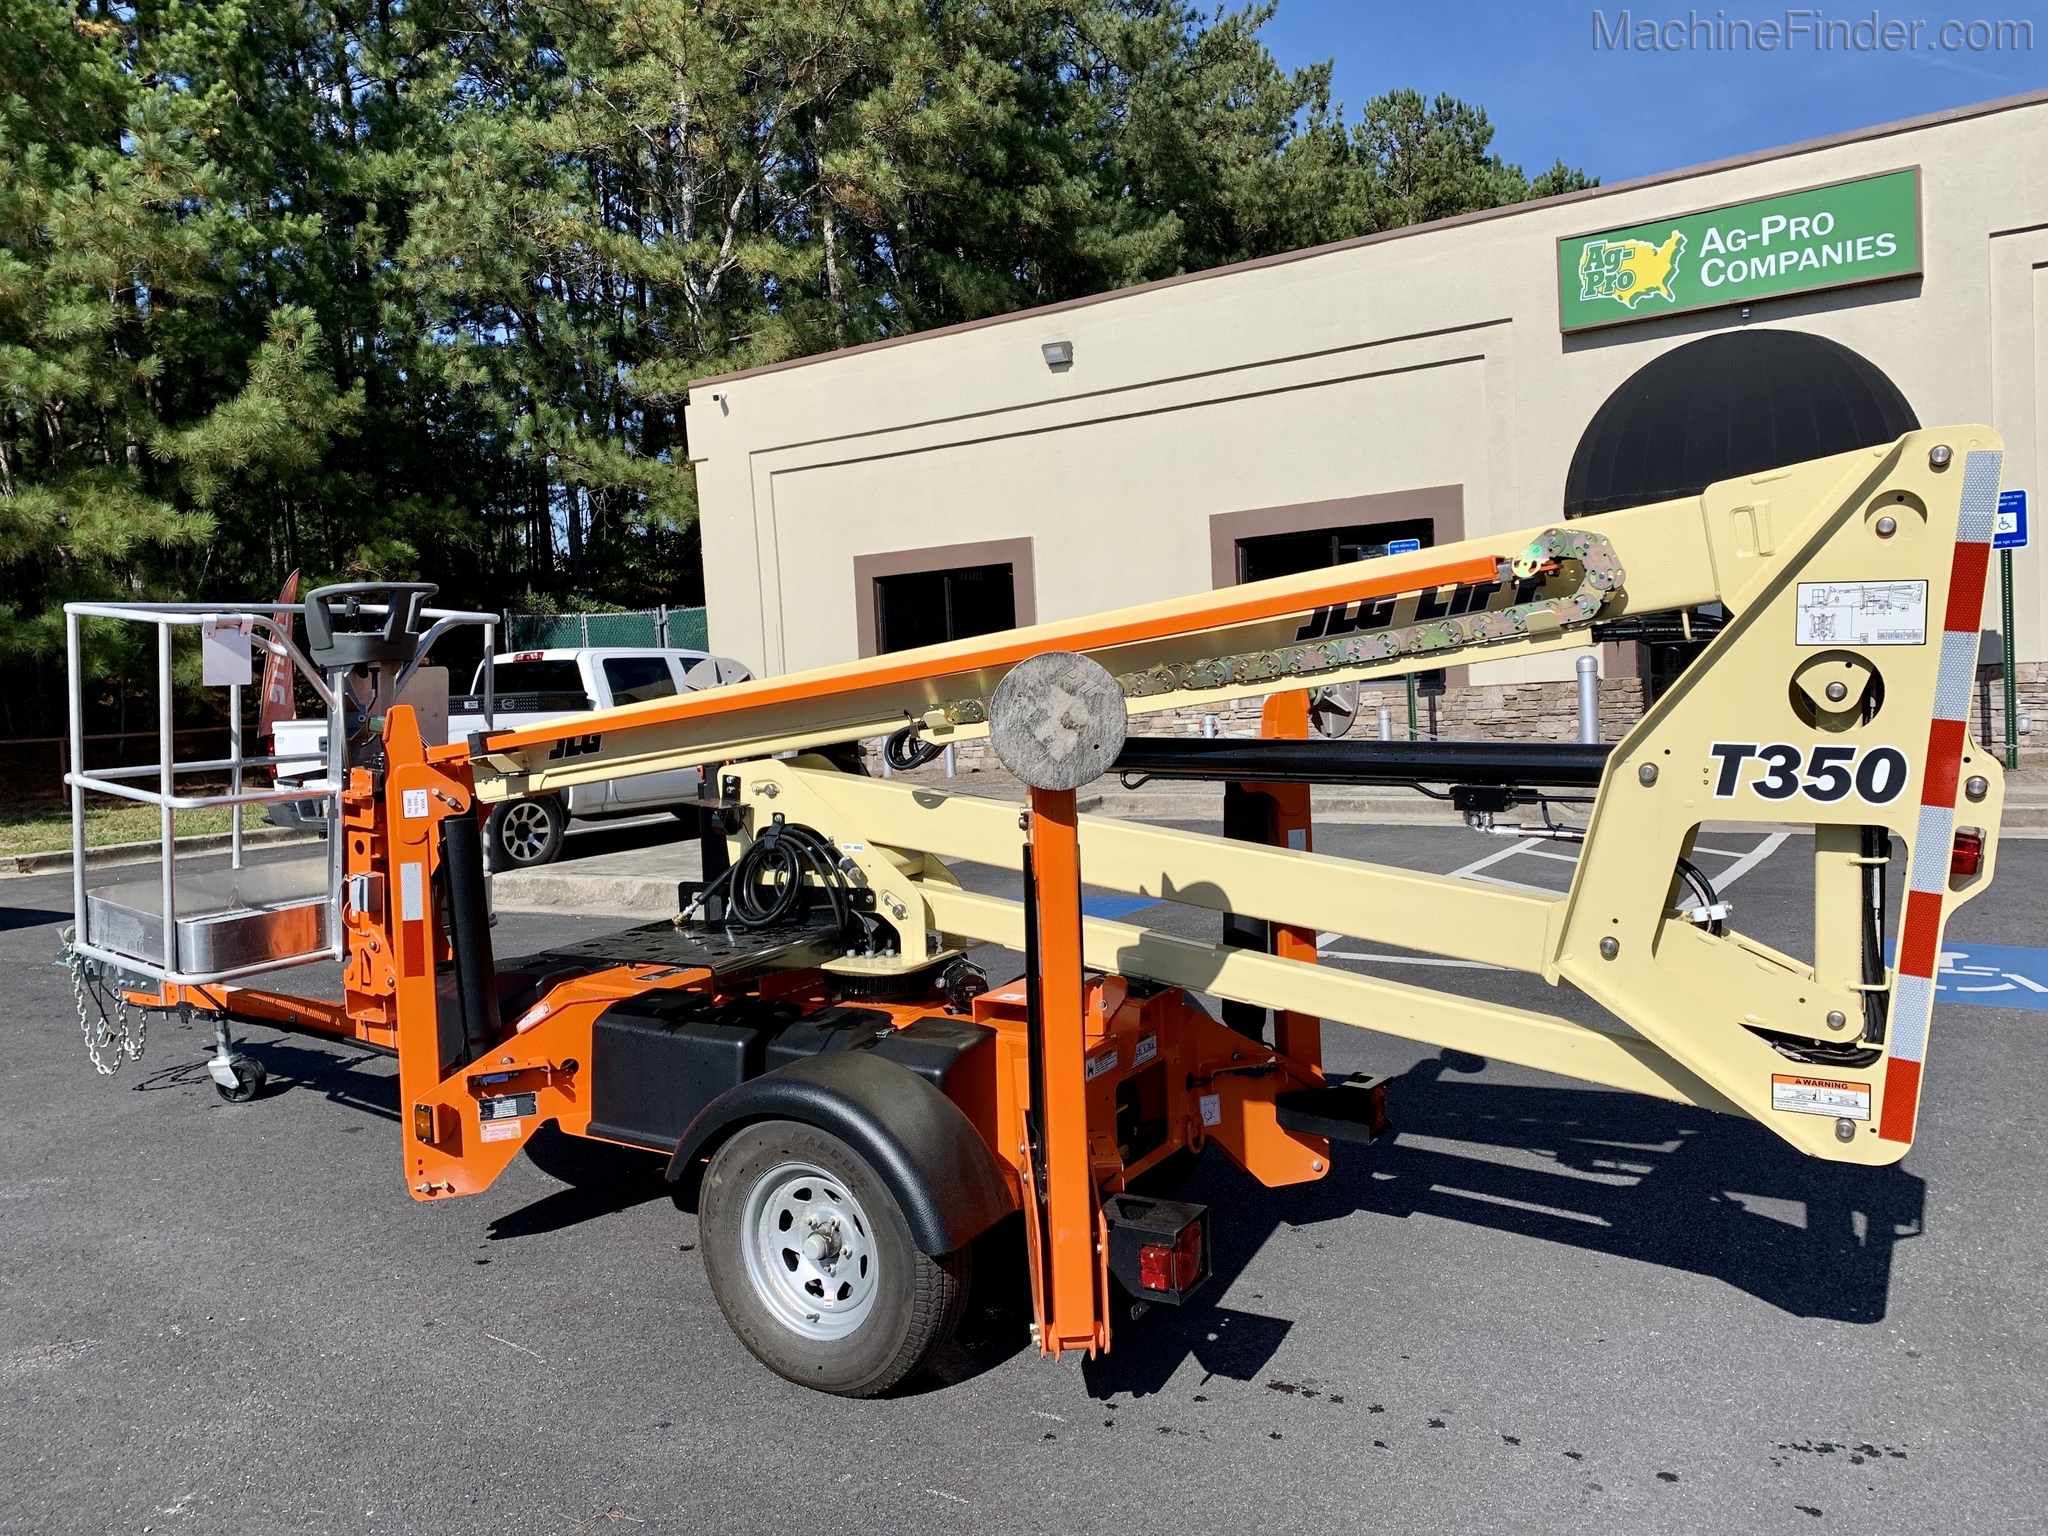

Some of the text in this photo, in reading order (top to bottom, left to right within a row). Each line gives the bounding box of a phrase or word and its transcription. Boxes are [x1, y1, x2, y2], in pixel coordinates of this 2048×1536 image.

[1582, 270, 1636, 299] Pro
[1295, 593, 1398, 642] JLG
[547, 733, 602, 761] JLG
[1710, 742, 1909, 804] T350
[1803, 1079, 1848, 1090] WARNING
